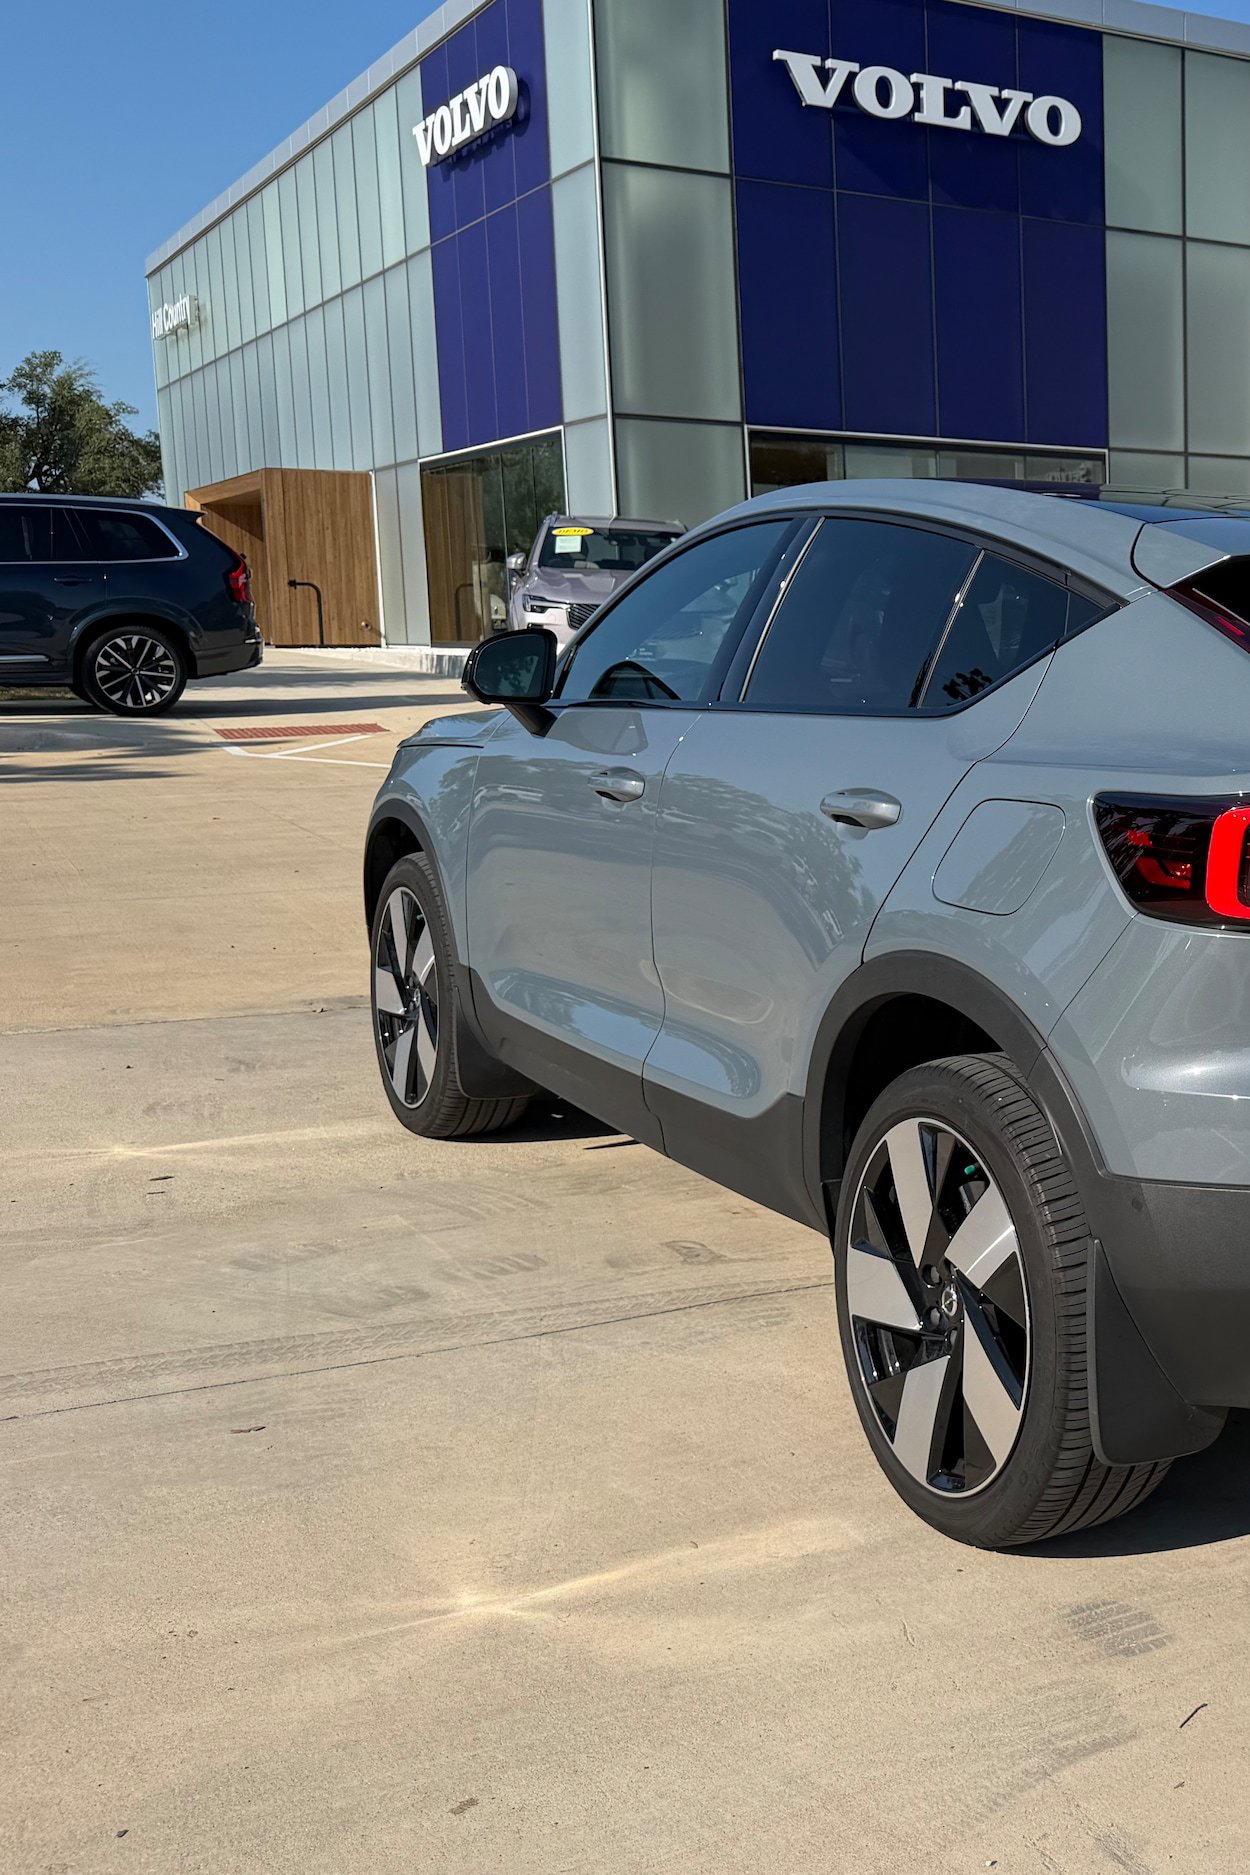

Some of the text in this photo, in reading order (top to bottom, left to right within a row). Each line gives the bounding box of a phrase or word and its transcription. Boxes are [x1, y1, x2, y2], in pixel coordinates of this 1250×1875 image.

[411, 65, 515, 167] VOLVO
[772, 48, 1083, 147] VOLVO
[163, 293, 190, 331] Country
